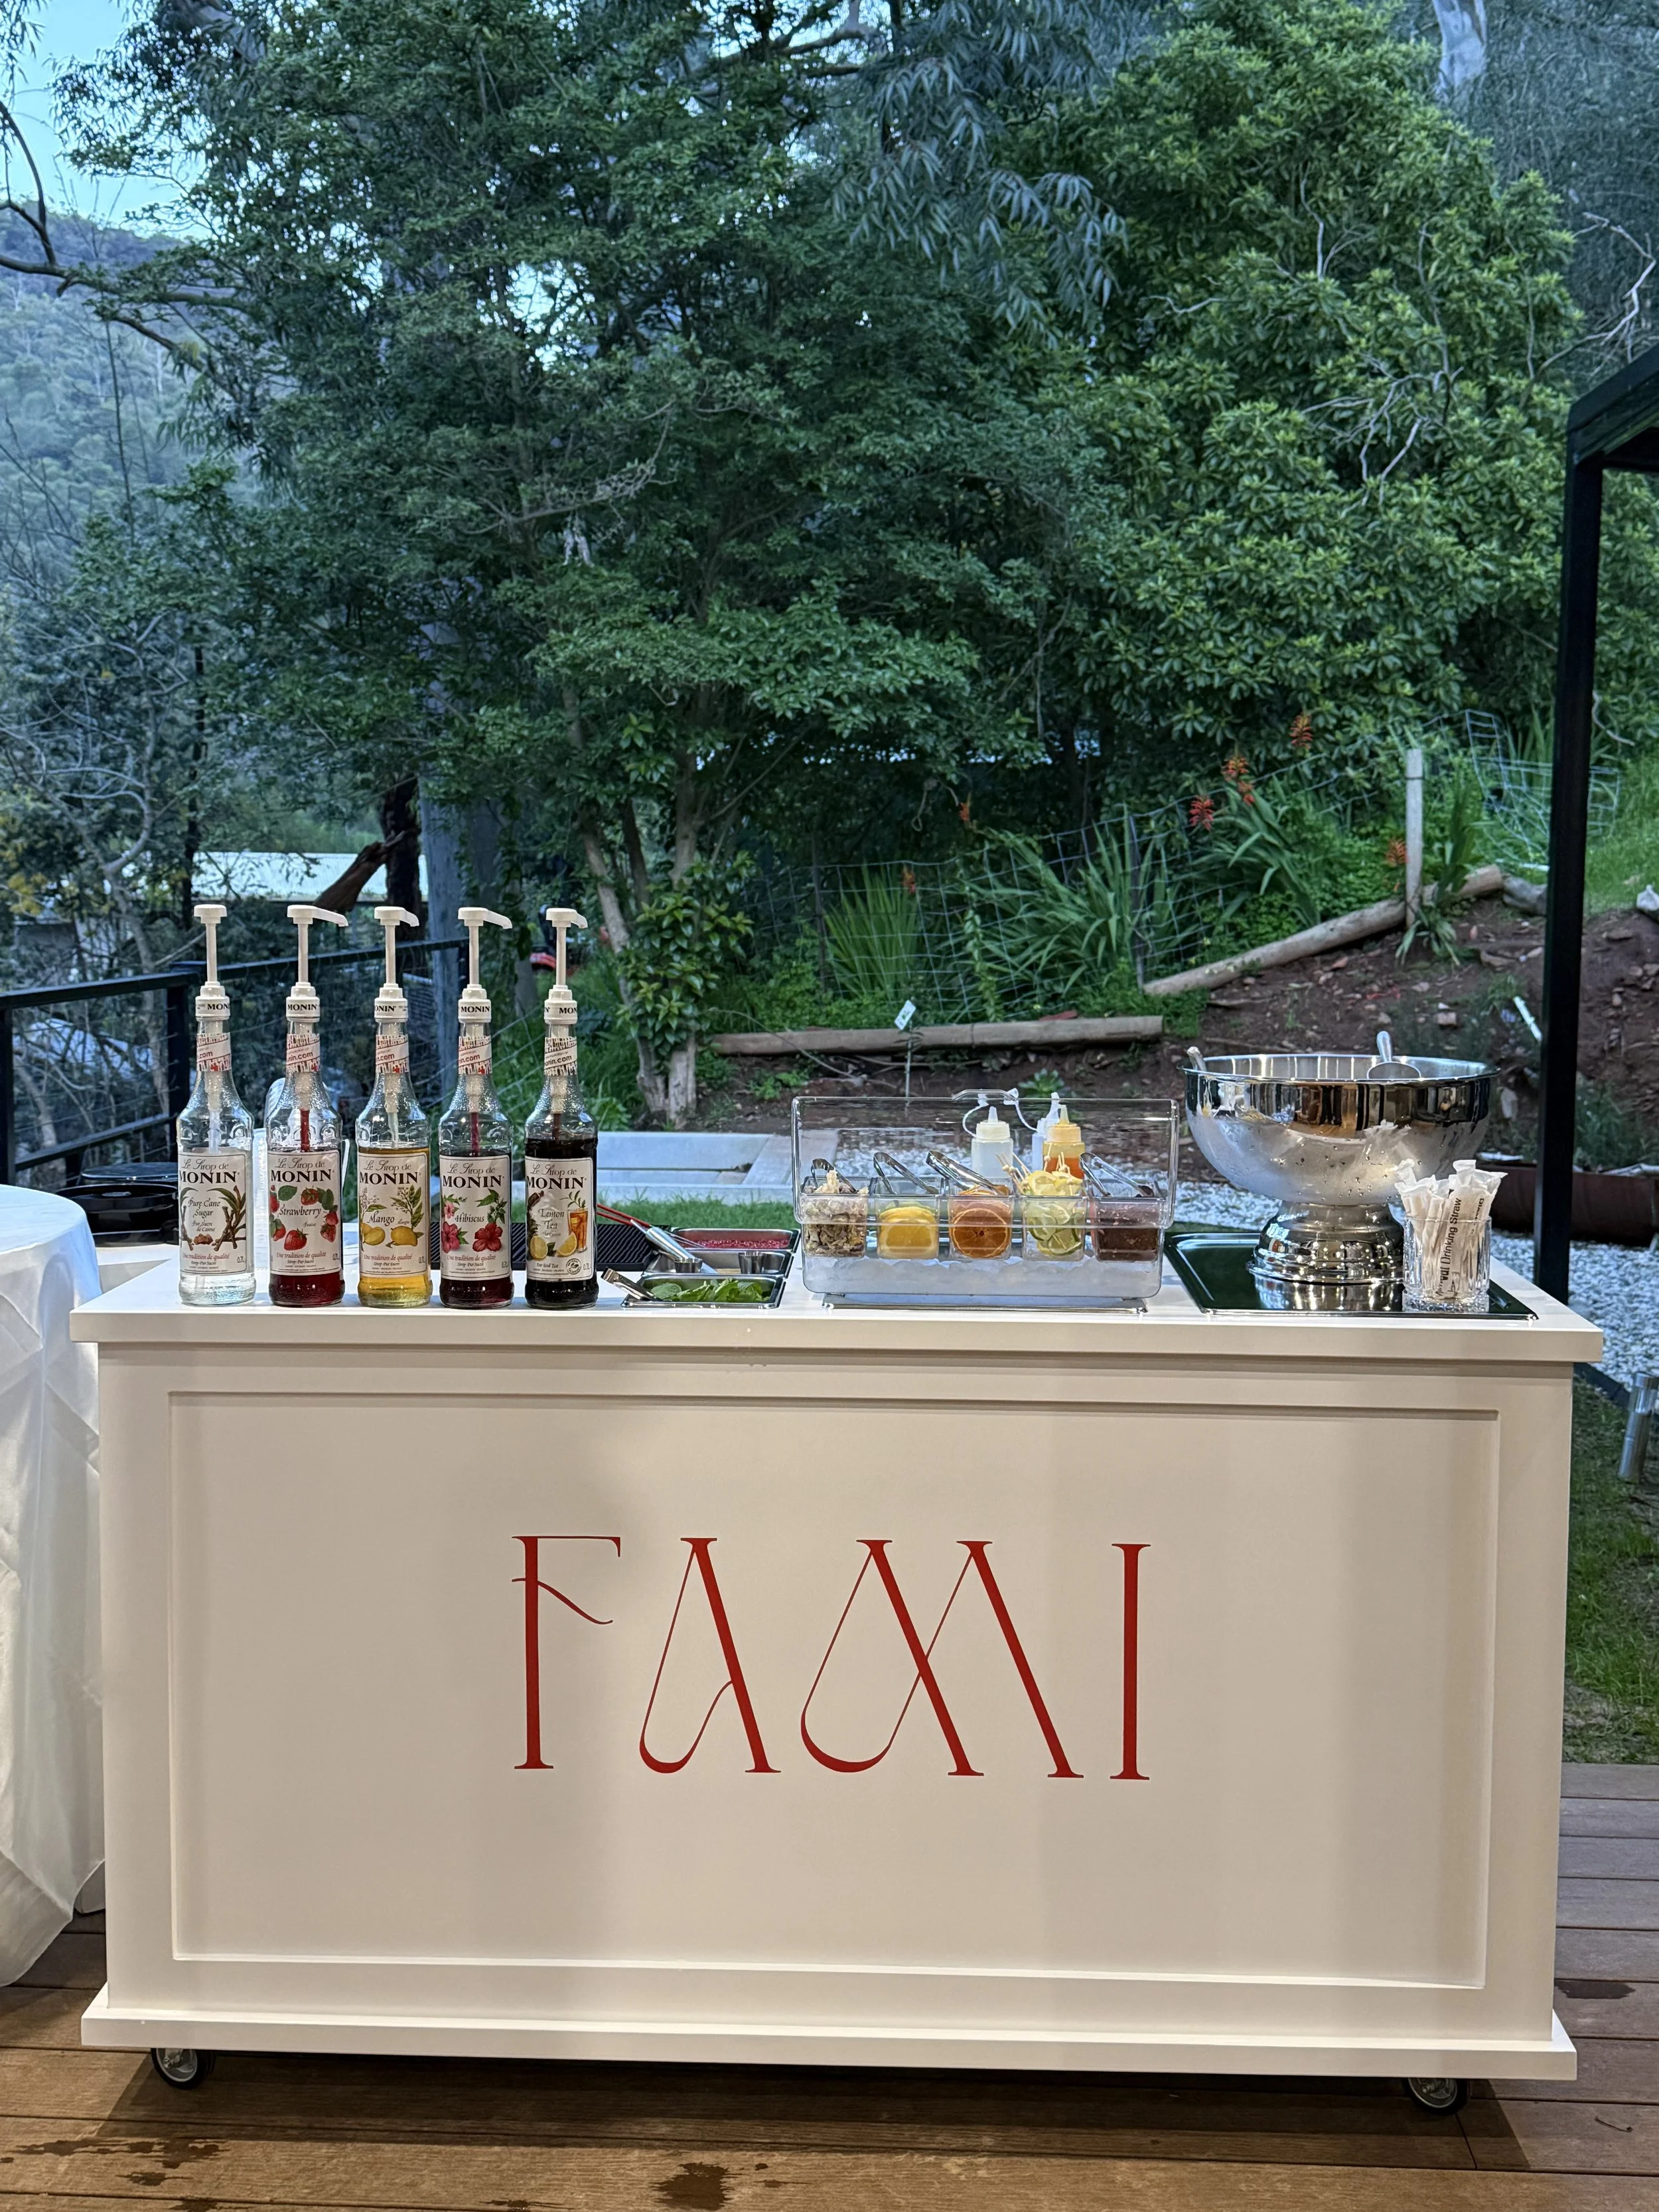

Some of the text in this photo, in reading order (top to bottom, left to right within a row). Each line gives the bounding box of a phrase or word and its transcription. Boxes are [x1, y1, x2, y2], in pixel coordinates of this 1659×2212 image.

[181, 1159, 191, 1169] Le
[192, 1159, 216, 1172] Sirop
[275, 1157, 286, 1168] Le
[289, 1157, 313, 1171] Sirop
[364, 1160, 373, 1171] Le
[376, 1160, 399, 1173] Sirop
[447, 1163, 457, 1173] Le
[460, 1163, 483, 1177] Sirop
[530, 1164, 540, 1175] Le
[542, 1164, 565, 1177] Sirop
[179, 1170, 236, 1184] MONIN
[271, 1169, 331, 1183] MONIN
[360, 1171, 417, 1185] MONIN
[443, 1175, 501, 1188] MONIN
[527, 1175, 584, 1189] MONIN
[188, 1197, 220, 1210] Pure Cane
[193, 1209, 214, 1218] Sugar
[277, 1204, 322, 1218] Strawberry
[455, 1213, 484, 1222] Hibiscus
[538, 1209, 564, 1218] Lemon
[367, 1211, 395, 1226] Mango
[543, 1219, 557, 1229] Tea
[1441, 1226, 1458, 1264] Drinking
[1450, 1198, 1462, 1225] Straw
